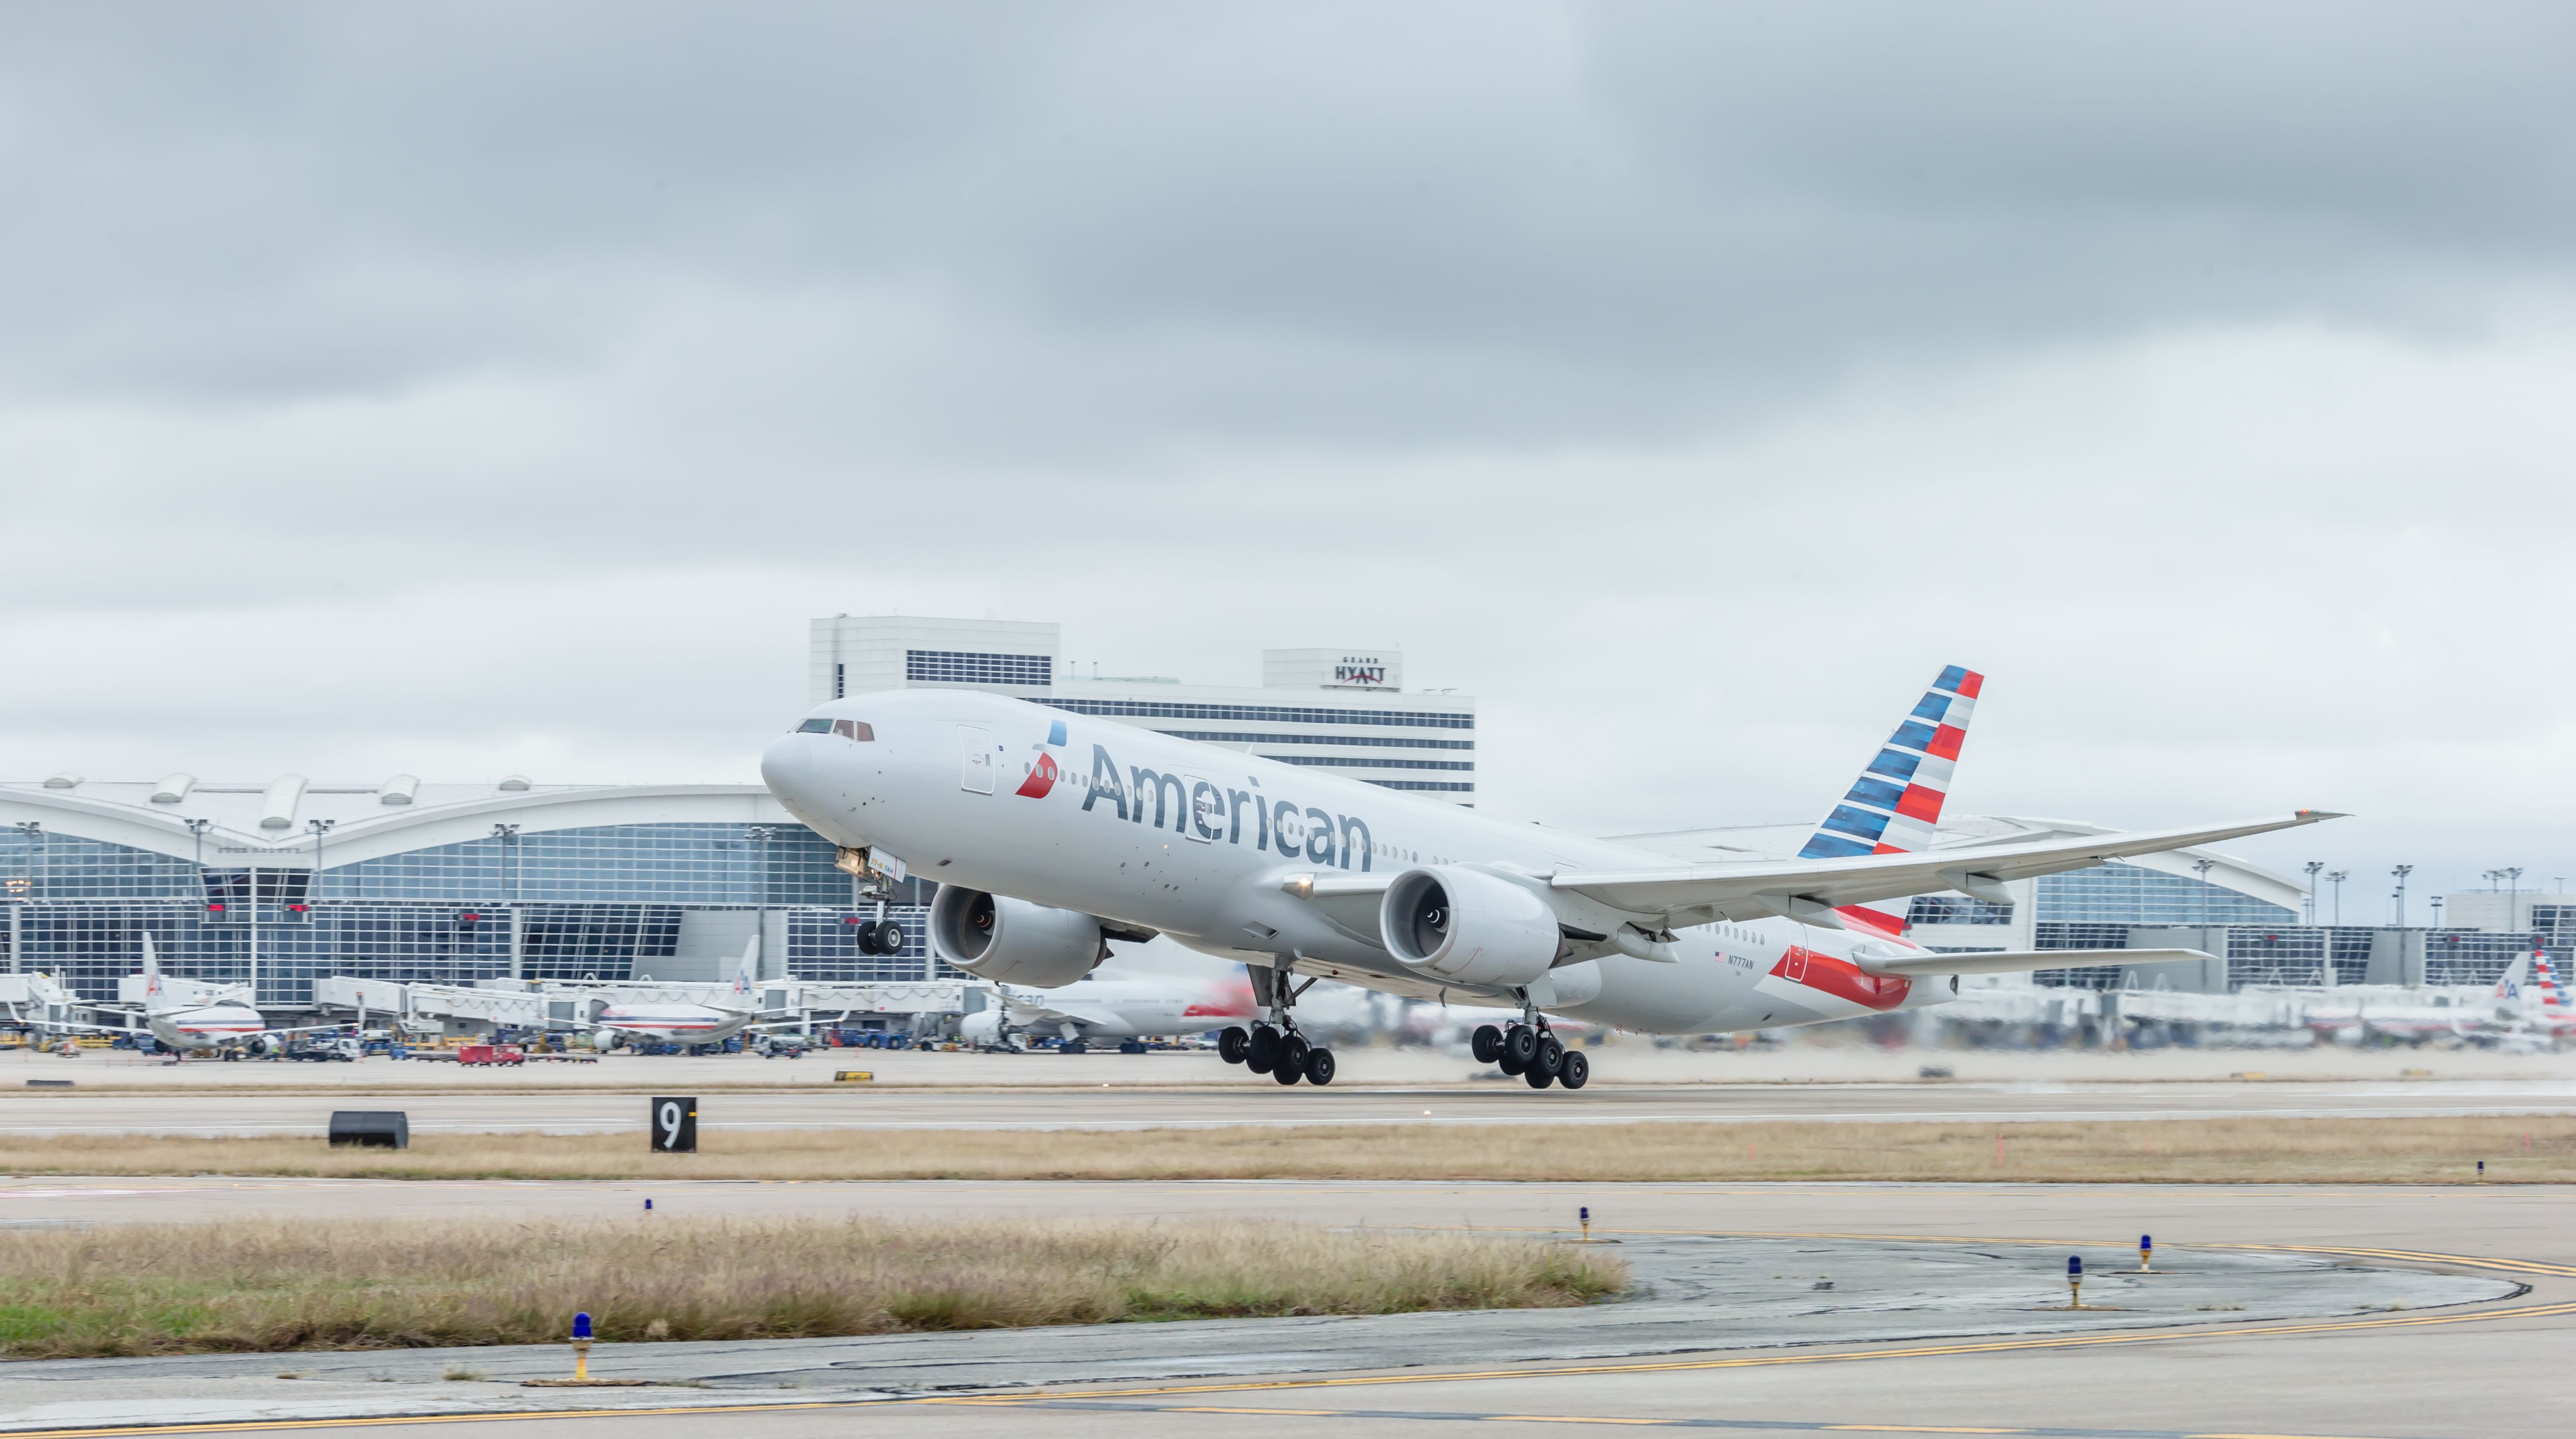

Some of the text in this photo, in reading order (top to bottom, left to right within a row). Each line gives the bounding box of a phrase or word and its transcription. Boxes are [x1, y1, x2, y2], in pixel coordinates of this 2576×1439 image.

[1335, 666, 1386, 684] HYATT
[1081, 744, 1371, 872] American
[884, 865, 894, 874] 7AH
[1728, 955, 1754, 970] N777AN
[660, 1102, 681, 1148] 9
